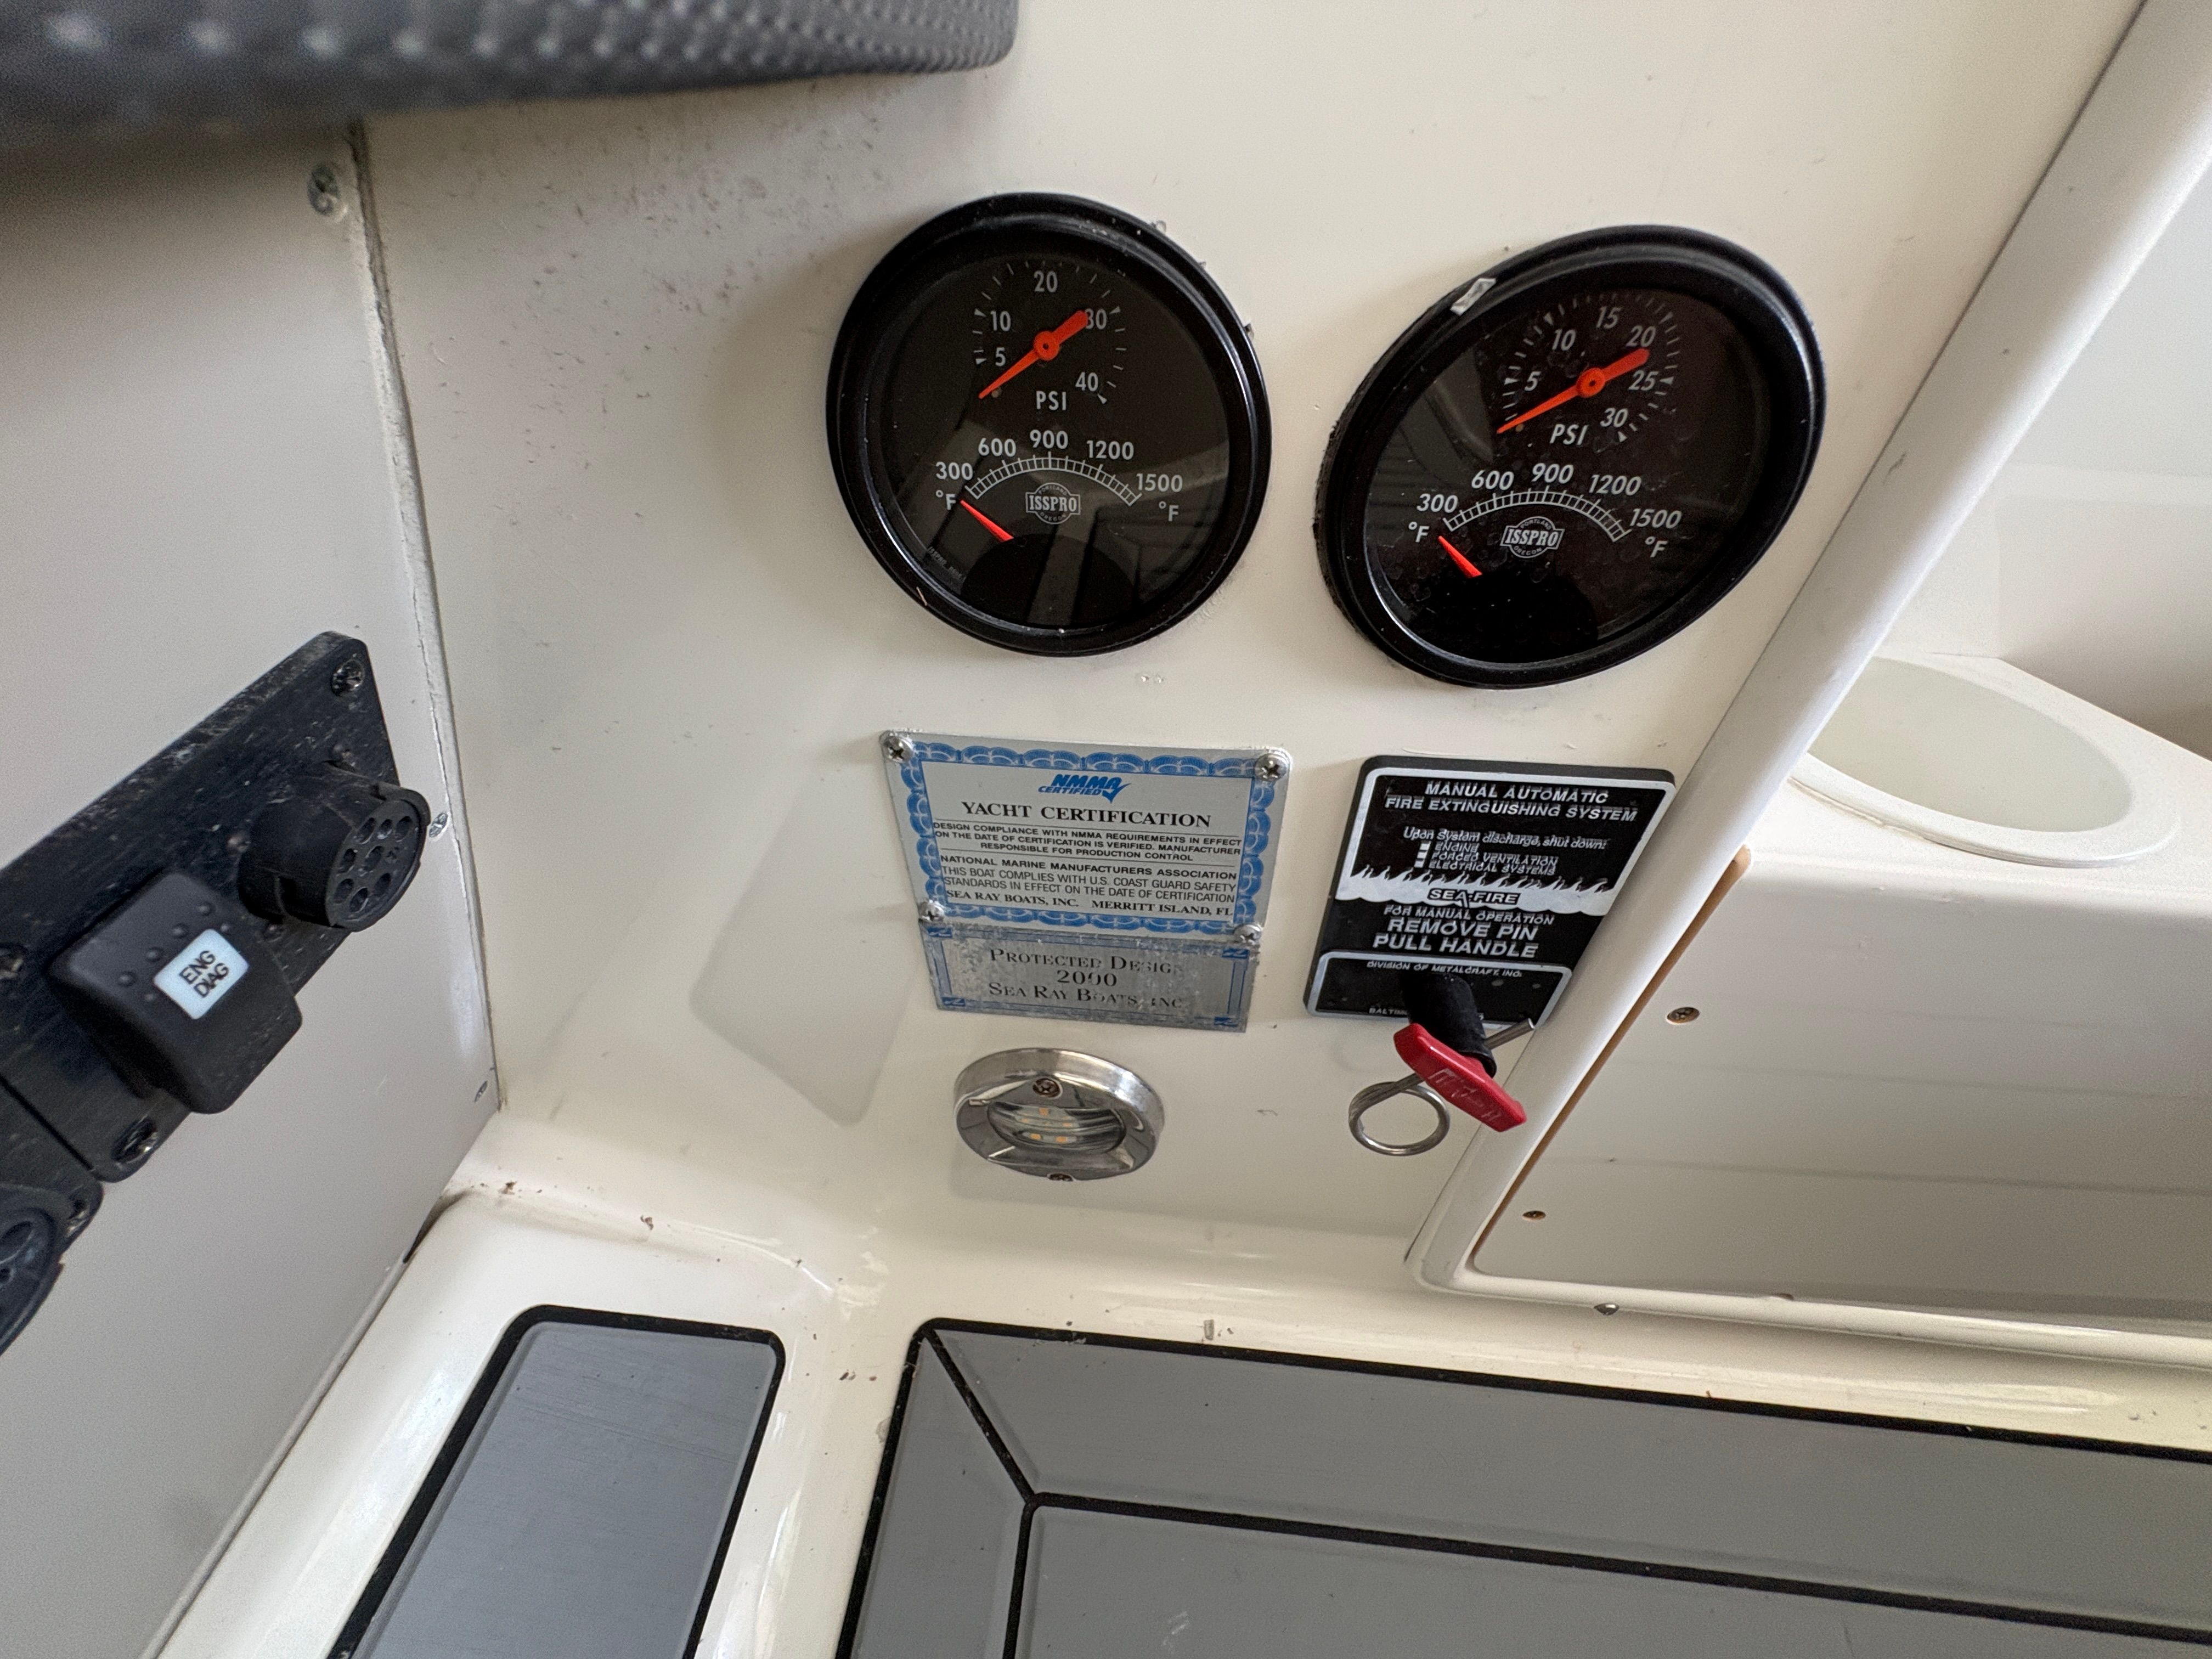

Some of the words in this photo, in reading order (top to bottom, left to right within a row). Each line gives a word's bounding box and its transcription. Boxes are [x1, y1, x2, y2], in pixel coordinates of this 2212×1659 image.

[1034, 271, 1058, 293] 20
[990, 311, 1011, 331] 10
[1085, 308, 1107, 329] 30
[1596, 307, 1621, 329] 15
[1551, 330, 1576, 351] 10
[1626, 326, 1656, 348] 20
[995, 347, 1006, 366] 5
[1075, 372, 1098, 391] 40
[1525, 371, 1541, 391] 5
[1628, 371, 1657, 391] 25
[1035, 391, 1068, 411] PSI
[1600, 408, 1628, 427] 30
[1030, 430, 1069, 449] 900
[1550, 424, 1588, 445] PSI
[978, 438, 1017, 456] 600
[1086, 441, 1134, 460] 1200
[935, 462, 973, 481] 300
[1471, 471, 1514, 490] 600
[1532, 464, 1573, 484] 900
[1136, 473, 1183, 492] 1500
[1588, 475, 1641, 495] 1200
[1029, 495, 1077, 512] ISSPRO
[1417, 494, 1458, 514] 300
[1629, 508, 1682, 529] 1500
[1505, 528, 1559, 546] ISSPRO
[1514, 545, 1542, 556] OREGON
[1038, 785, 1101, 795] CERTIFIED
[1051, 774, 1122, 790] NMMA
[1425, 781, 1498, 798] MANUAL
[1503, 787, 1609, 804] AUTOMATIC
[961, 802, 1032, 818] YACHT
[1041, 806, 1211, 828] CERTIFICATION
[1385, 796, 1424, 810] FIRE
[1428, 799, 1560, 817] EXTINGUISHING
[1565, 807, 1638, 822] SYSTEM
[933, 822, 970, 831] DESIGN
[973, 825, 1039, 835] COMPLIANCE
[1042, 829, 1068, 837] WITH
[1071, 831, 1102, 839] NMMA
[1106, 833, 1186, 844] REQUIREMENTS
[1203, 838, 1242, 847] EFFECT
[1403, 827, 1435, 840] Upon
[1436, 830, 1480, 843] System
[1542, 836, 1570, 848] shut
[980, 842, 1049, 853] RESPONSIBLE
[1052, 847, 1073, 855] FOR
[1076, 849, 1141, 859] PRODUCTION
[1144, 851, 1193, 861] CONTROL
[1018, 837, 1091, 847] CERTIFICATION
[1159, 844, 1241, 855] MANUFACTURER
[1435, 842, 1480, 853] ENGINE
[940, 855, 997, 866] NATIONAL
[1002, 859, 1046, 869] MARINE
[1050, 862, 1152, 876] MANUFACTURERS
[1157, 868, 1237, 880] ASSOCIATION
[1428, 860, 1498, 872] ELECTRICAL
[1500, 865, 1556, 876] SYSTEMS
[1431, 852, 1480, 862] FORCED
[1482, 853, 1559, 867] VENTILATION
[942, 866, 967, 876] THIS
[969, 868, 995, 878] BOAT
[999, 870, 1055, 882] COMPLIES
[1057, 874, 1086, 884] WITH
[1090, 876, 1109, 885] U.S.
[1113, 877, 1149, 888] COAST
[1152, 879, 1191, 890] GUARD
[1194, 882, 1237, 893] SAFETY
[944, 877, 1007, 889] STANDARDS
[1010, 881, 1021, 890] IN
[1024, 882, 1062, 893] EFFECT
[1065, 884, 1081, 894] ON
[1084, 886, 1105, 896] THE
[1108, 887, 1135, 898] DATE
[1138, 889, 1153, 899] OF
[1155, 890, 1235, 903] CERTIFICATION
[946, 890, 972, 900] SEA
[974, 891, 1001, 901] RAY
[1091, 900, 1155, 912] MERRITT
[1159, 904, 1212, 916] ISLAND,
[1384, 906, 1412, 916] FOR
[1415, 907, 1471, 921] MANUAL
[1476, 911, 1555, 926] OPERATION
[1387, 917, 1491, 938] REMOVE
[1496, 924, 1538, 941] PIN
[1373, 934, 1432, 951] PULL
[1439, 938, 1539, 958] HANDLE
[179, 950, 216, 985] ENG
[1367, 961, 1410, 970] DIVISION
[193, 962, 229, 998] DIAG
[1057, 969, 1118, 987] 2000
[989, 982, 1026, 997] SEA
[1034, 985, 1068, 1000] RAY
